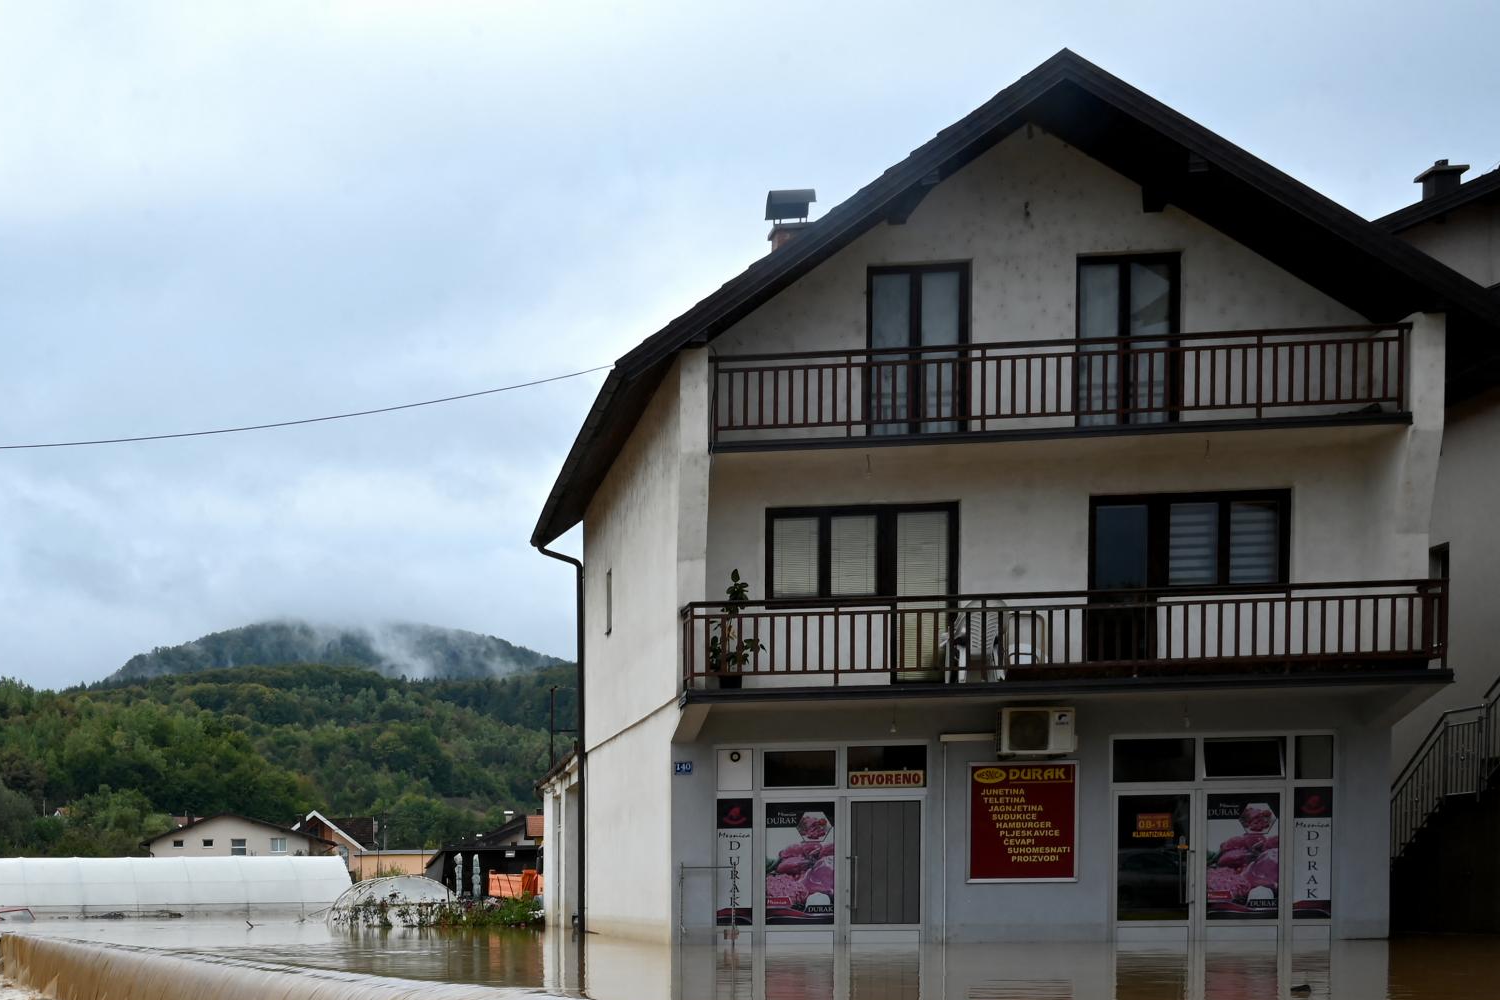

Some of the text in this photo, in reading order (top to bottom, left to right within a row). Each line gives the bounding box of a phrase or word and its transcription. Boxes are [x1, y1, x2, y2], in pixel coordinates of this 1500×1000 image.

[676, 763, 691, 771] 140
[1009, 768, 1066, 780] DURAK
[850, 772, 921, 786] OTVORENO
[983, 796, 1025, 804] TELETINA
[1208, 808, 1241, 818] DURAK
[766, 816, 797, 825] DURAK
[1000, 829, 1060, 837] PLJESKAVICE
[1307, 830, 1320, 899] DURAK
[729, 840, 741, 907] DURAK
[1250, 899, 1278, 908] DURAK
[808, 905, 834, 913] DURAK
